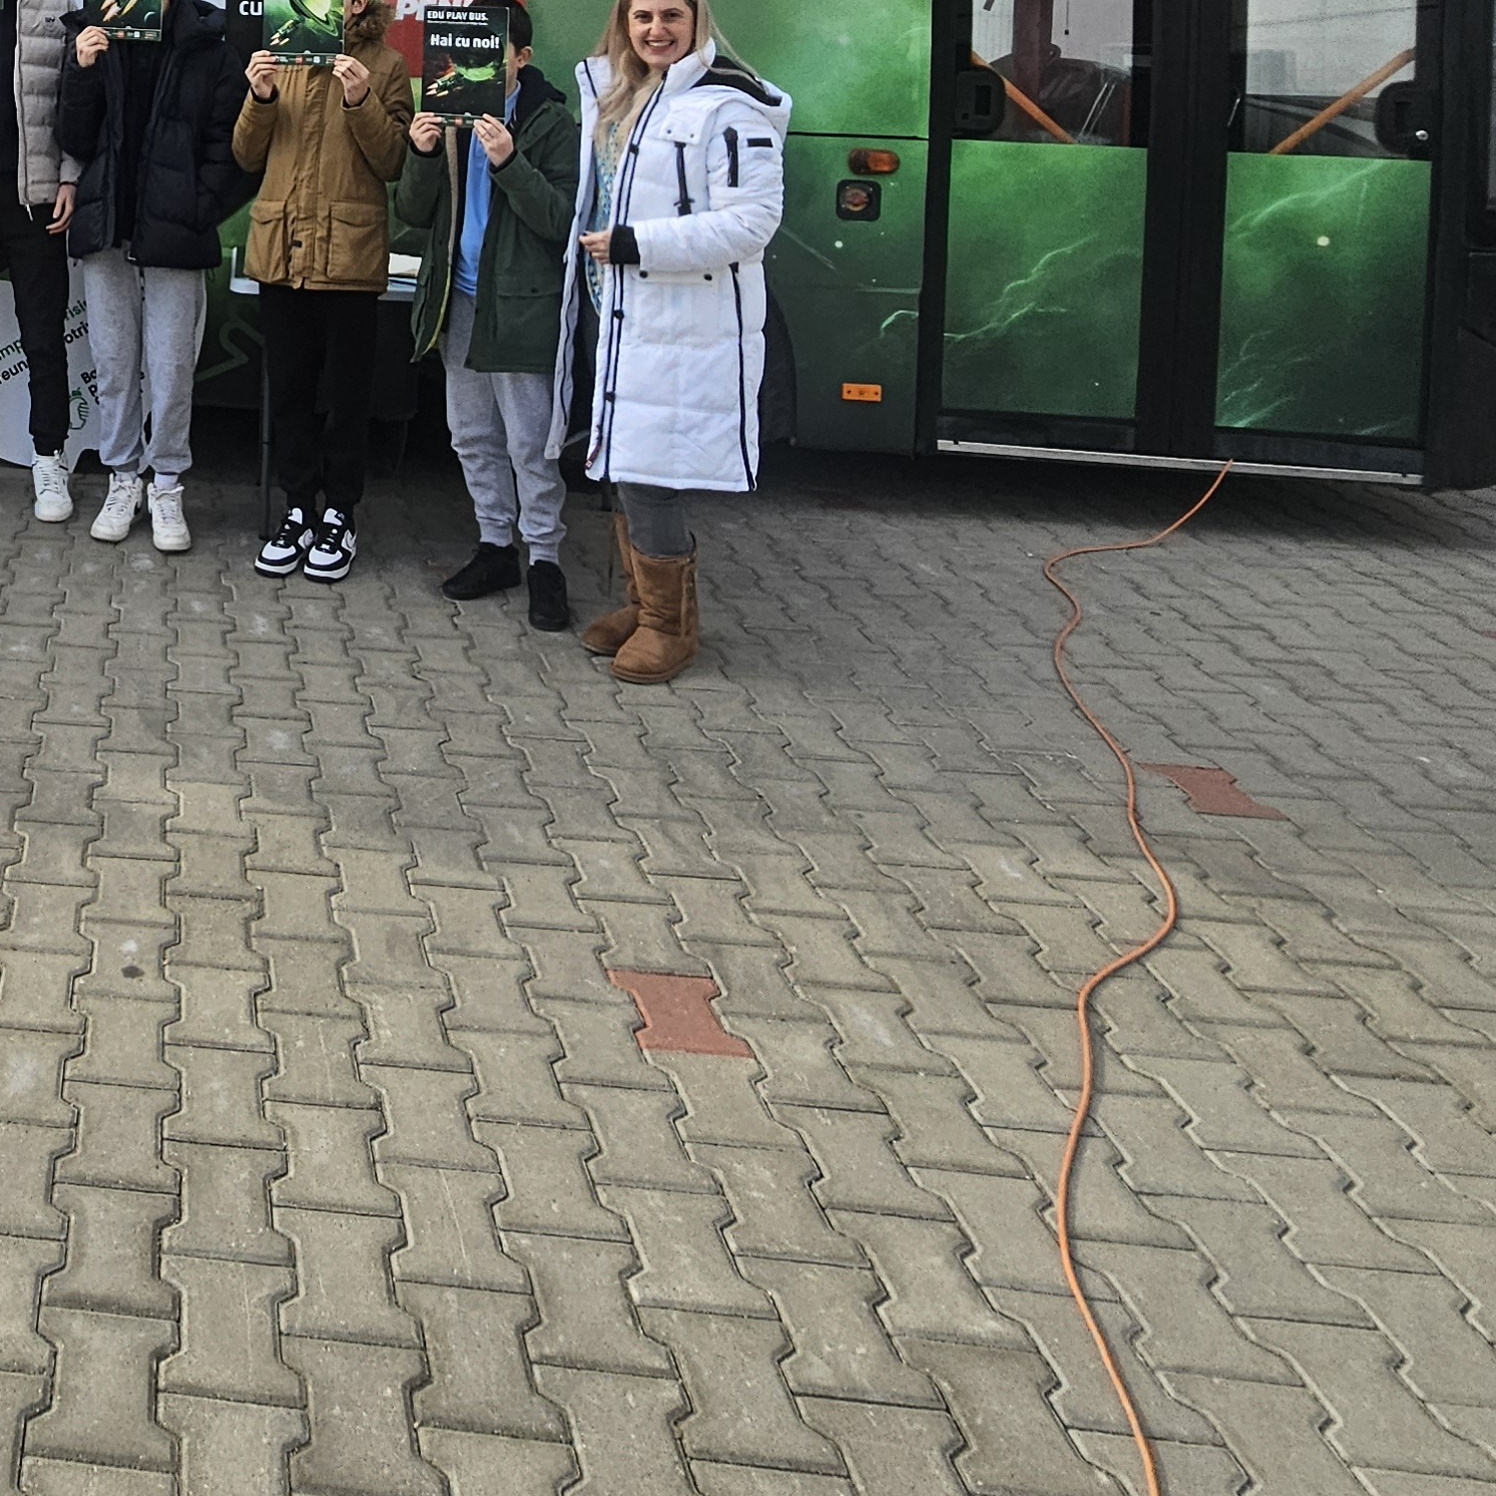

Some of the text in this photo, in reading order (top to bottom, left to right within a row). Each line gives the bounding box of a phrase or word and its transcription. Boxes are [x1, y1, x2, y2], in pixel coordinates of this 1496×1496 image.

[430, 33, 500, 49] Hai cu noi!
